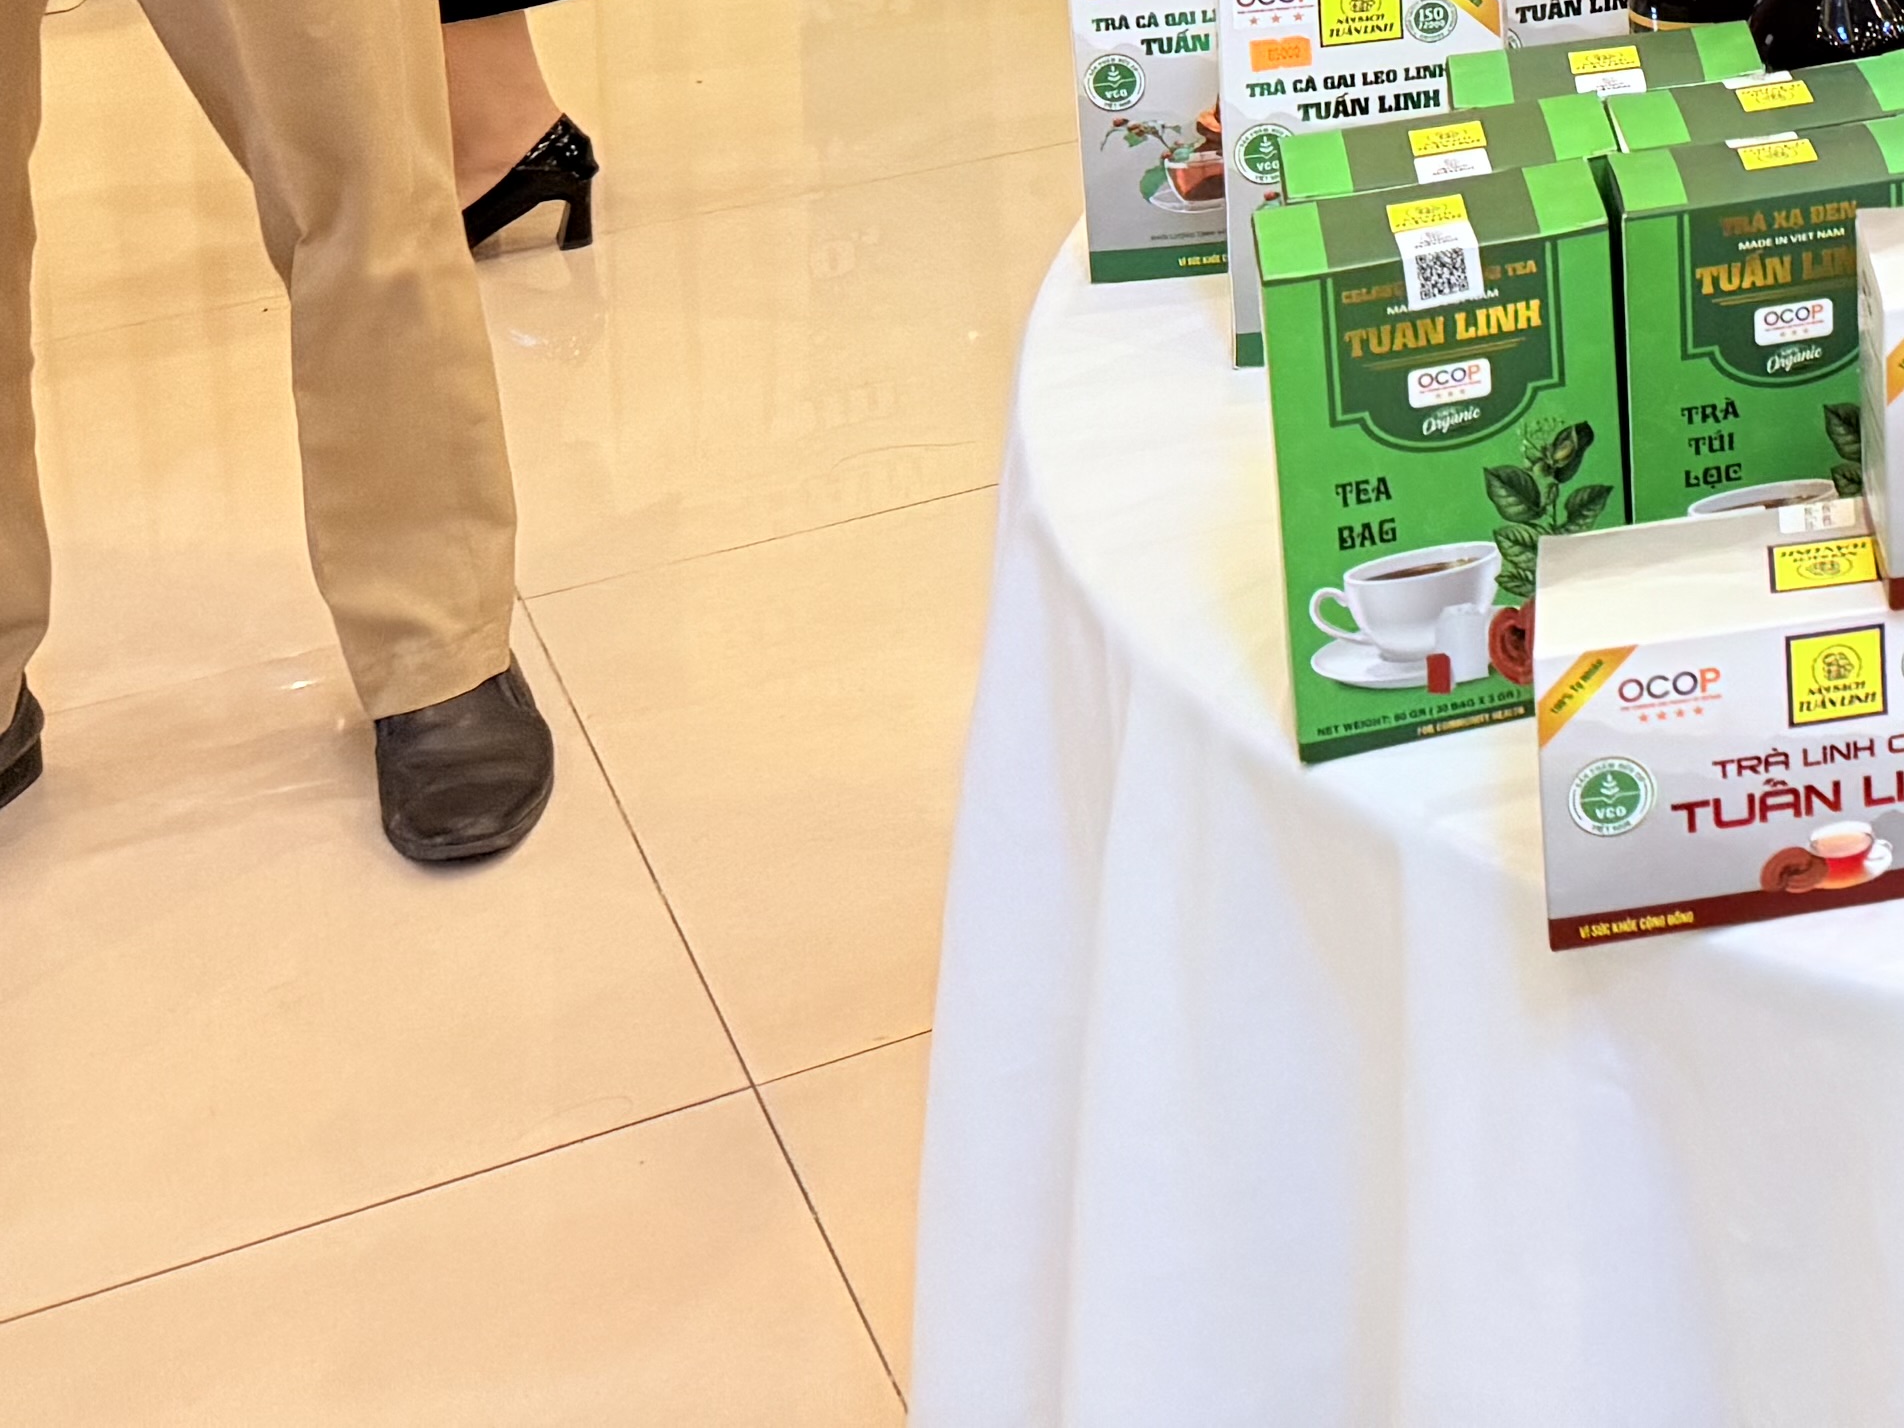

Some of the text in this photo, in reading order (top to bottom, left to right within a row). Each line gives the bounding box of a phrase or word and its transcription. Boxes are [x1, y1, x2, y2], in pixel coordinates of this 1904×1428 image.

[1092, 14, 1130, 33] TRÀ
[1136, 10, 1160, 29] CÀ
[1141, 28, 1211, 56] TUẤN
[1245, 63, 1447, 98] TRÀ CÀ GAI LEO LINH
[1297, 89, 1441, 122] TUẤN LINH
[1738, 227, 1845, 251] MADE IN VIET NAM
[1505, 260, 1537, 276] TEA
[1344, 298, 1542, 358] TUAN LINH
[1764, 303, 1824, 326] OCOP
[1766, 345, 1823, 374] Organic
[1417, 363, 1481, 389] OCOP
[1422, 405, 1481, 436] Organic
[1681, 396, 1740, 425] TRÀ
[1688, 430, 1736, 456] TÚI
[1335, 476, 1393, 508] TEA
[1338, 517, 1398, 551] BAG
[1618, 666, 1722, 703] OCOP
[1712, 747, 1790, 780] TRÀ
[1802, 737, 1875, 768] LINH
[1595, 806, 1627, 820] VCO
[1671, 777, 1843, 834] TUẤN
